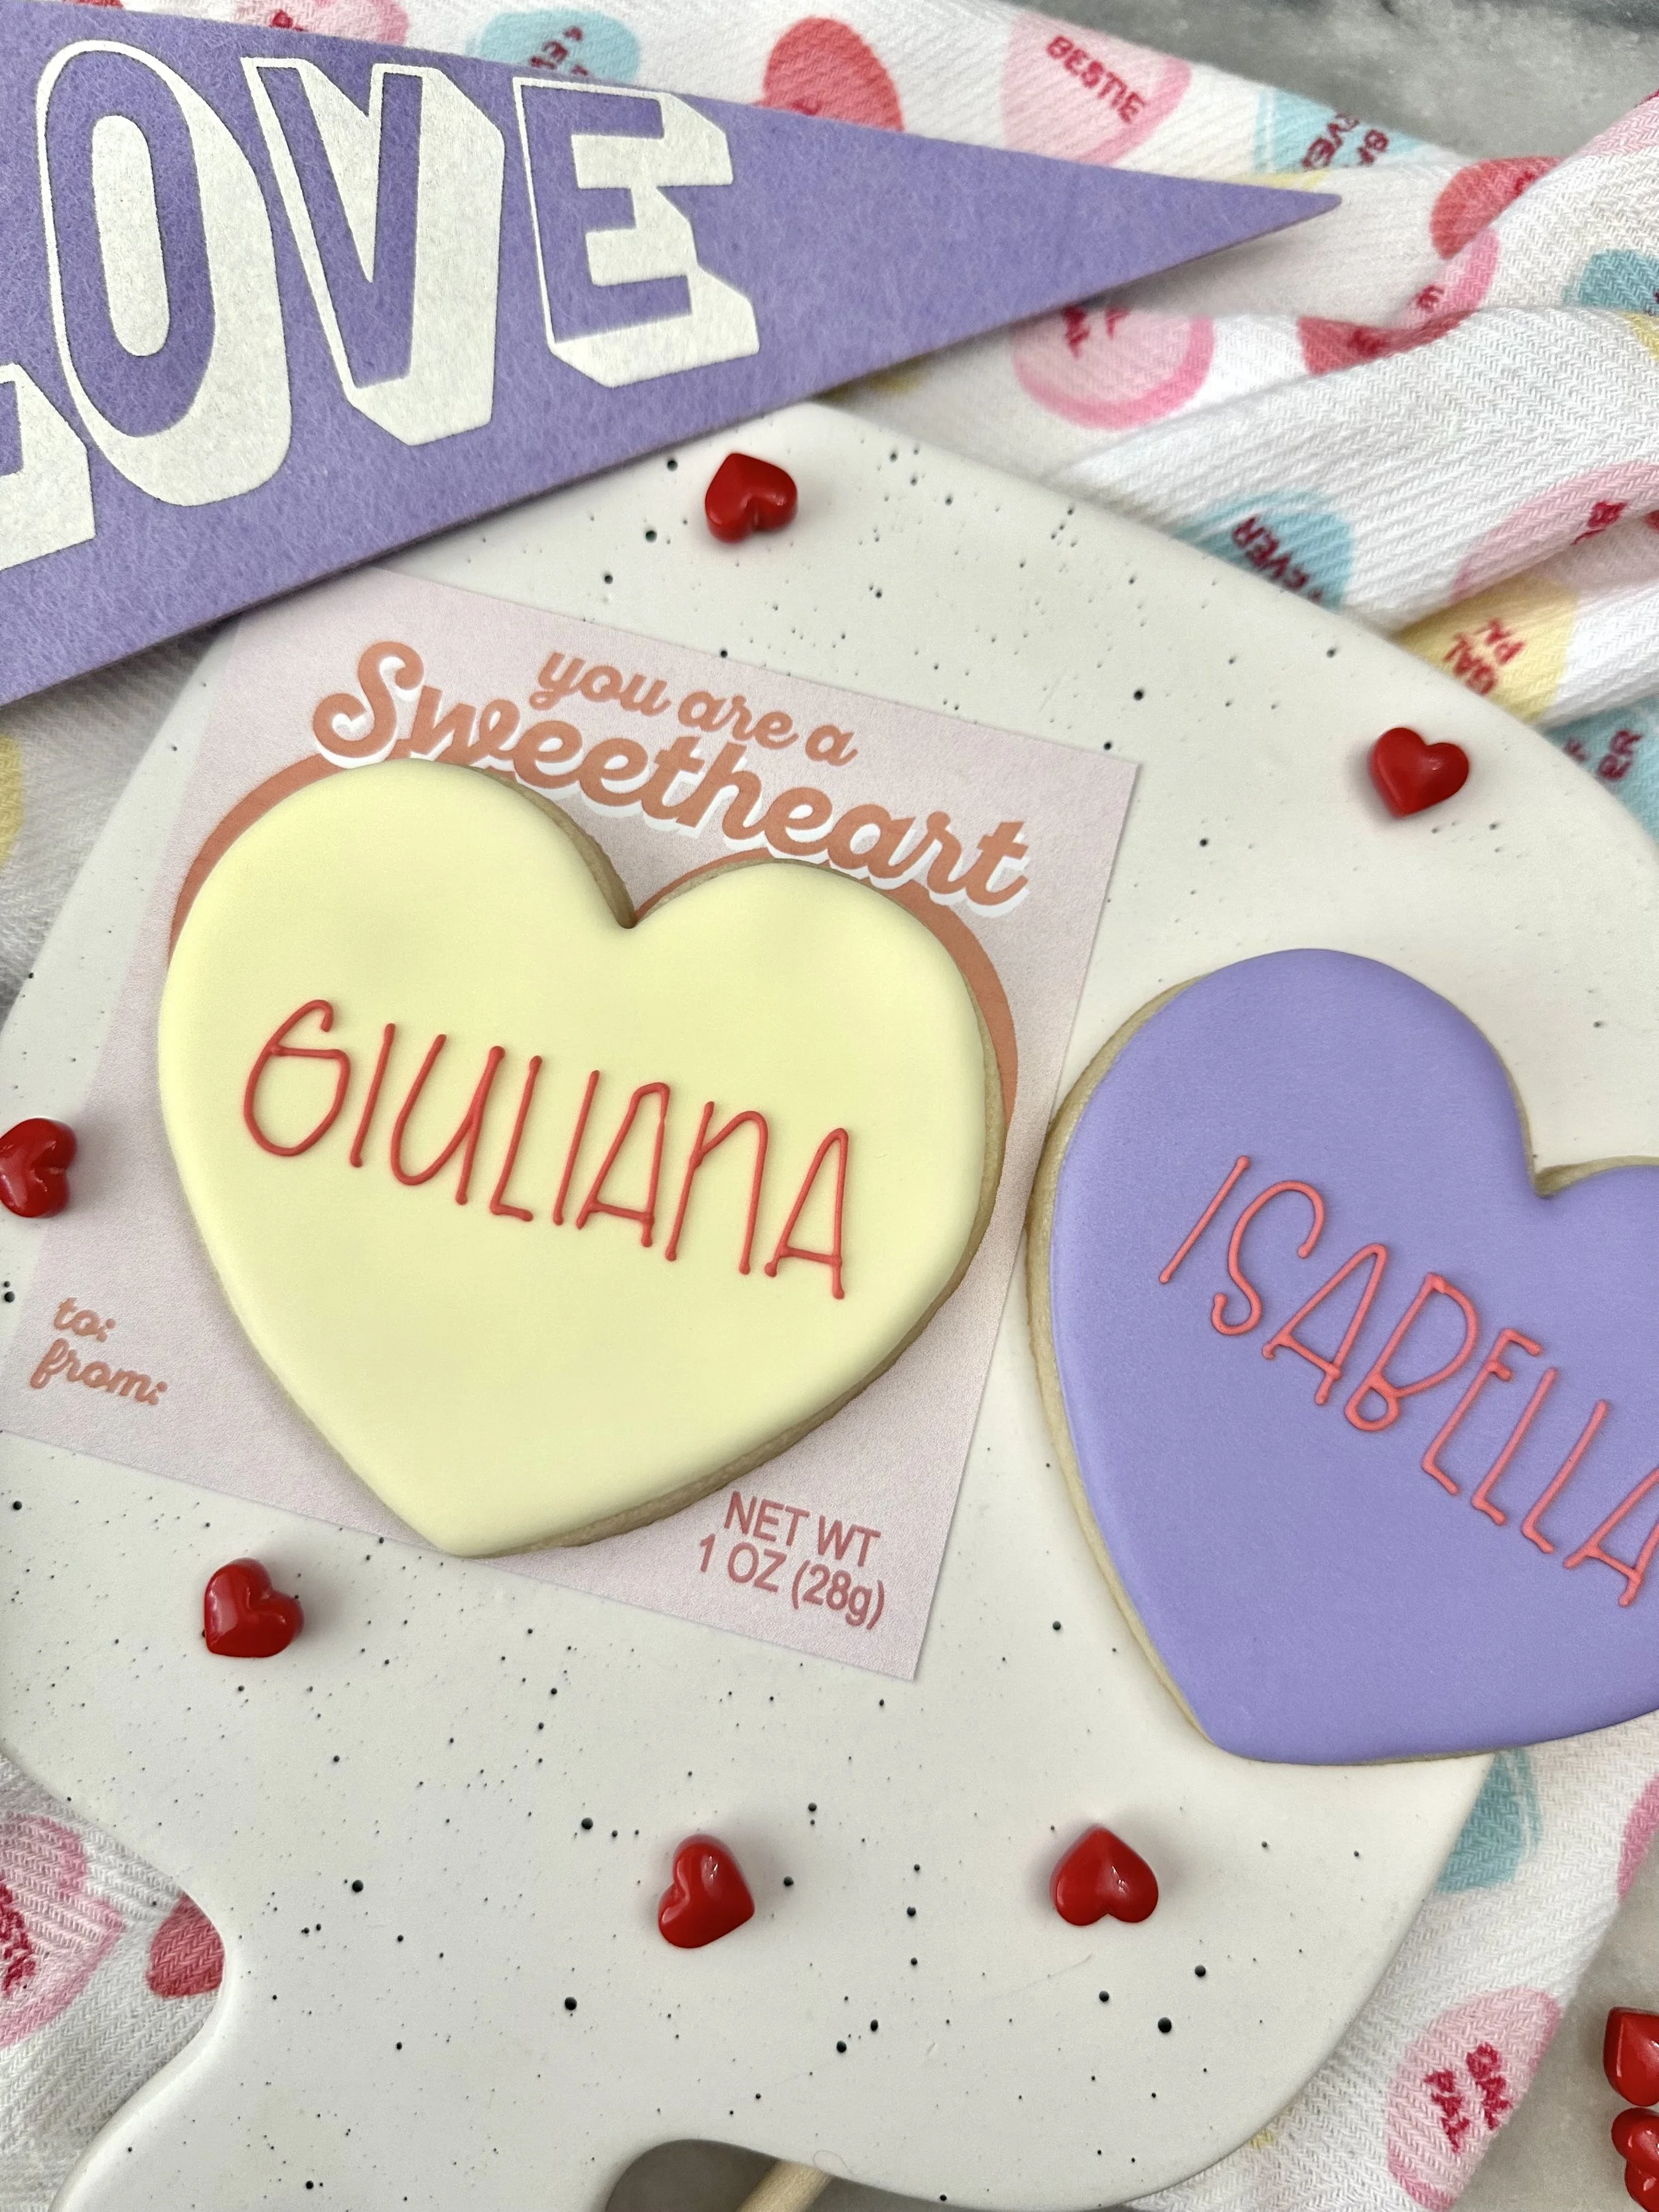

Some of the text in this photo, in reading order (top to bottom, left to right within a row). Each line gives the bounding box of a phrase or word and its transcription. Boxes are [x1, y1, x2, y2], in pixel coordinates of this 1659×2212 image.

[1045, 35, 1149, 124] BESTIE
[530, 651, 859, 767] you are a
[312, 640, 1031, 919] Sweetheart
[243, 999, 849, 1299] GIULIANA
[54, 1297, 116, 1342] to:
[30, 1337, 168, 1406] from:
[1159, 1155, 1659, 1607] ISABELLA
[724, 1491, 881, 1567] NET WT
[700, 1532, 885, 1630] 1 OZ (28g)
